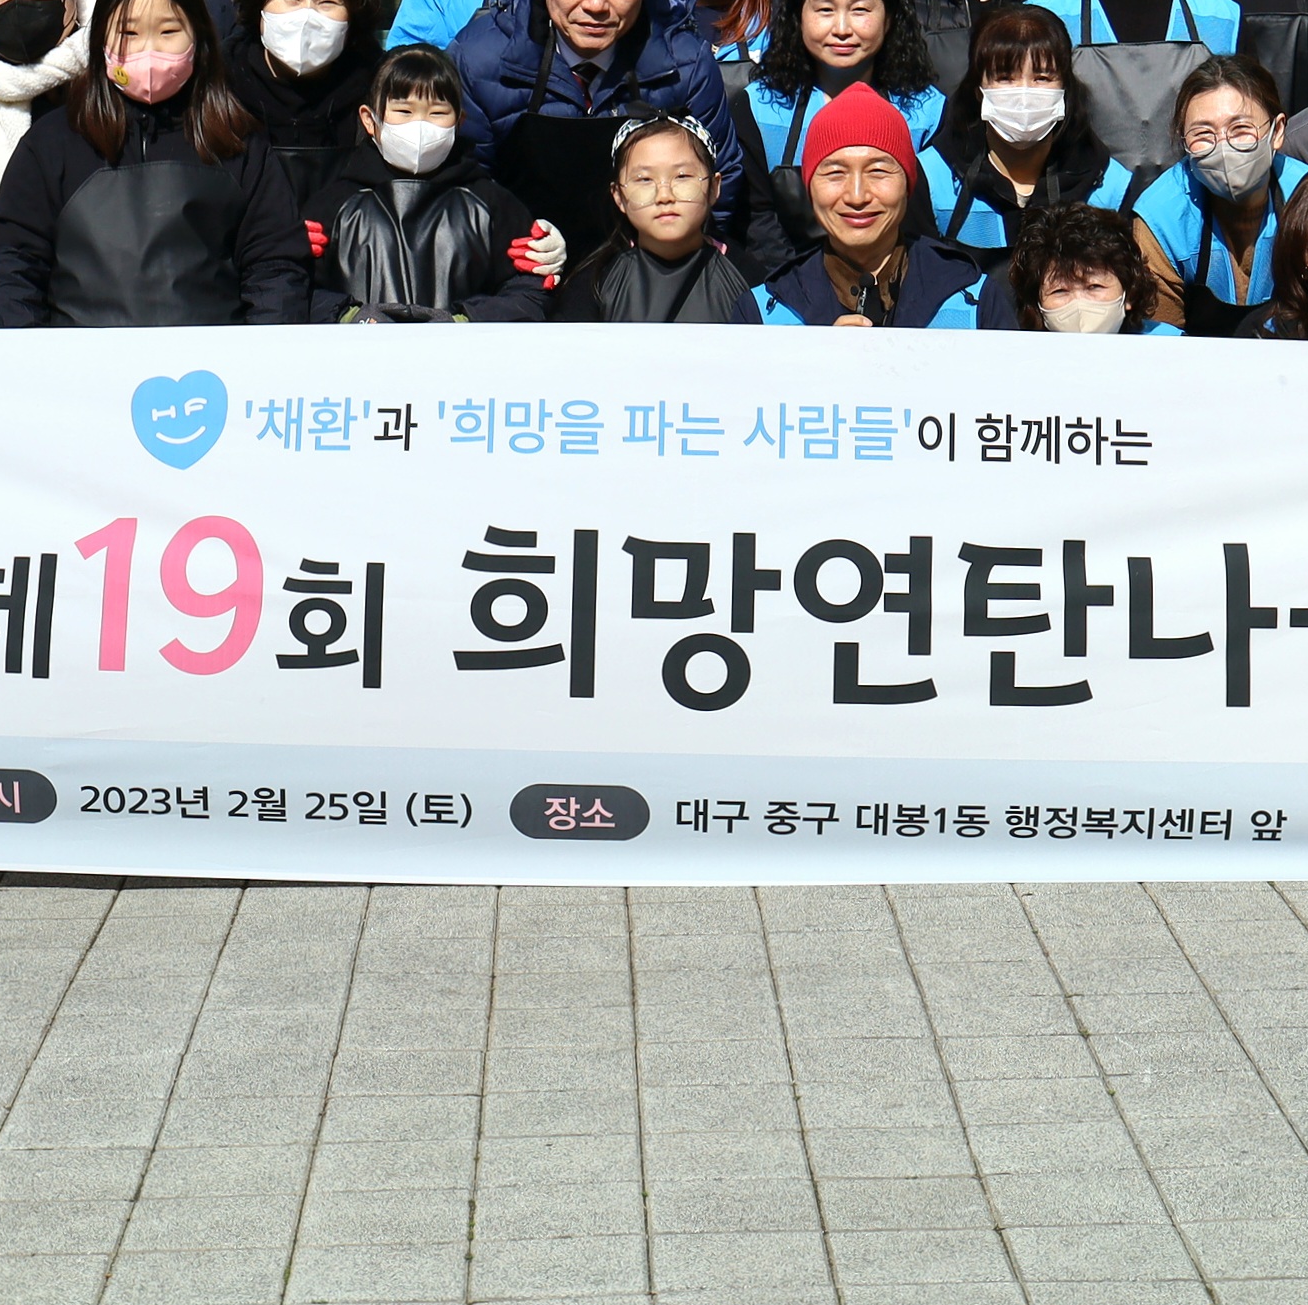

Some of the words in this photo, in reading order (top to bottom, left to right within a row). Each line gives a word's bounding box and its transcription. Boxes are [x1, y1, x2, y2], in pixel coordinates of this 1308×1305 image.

[245, 396, 419, 453] '채환'과
[437, 398, 606, 456] '희망을
[623, 402, 727, 458] 파는
[744, 404, 957, 463] 사람들'이
[976, 414, 1154, 467] 함께하는
[81, 786, 211, 821] 2023년
[229, 788, 288, 824] 2월
[305, 791, 389, 827] 25일
[406, 792, 473, 830] (토)
[544, 797, 617, 832] 장소
[677, 799, 751, 834] 대구
[764, 802, 841, 837] 중구
[857, 803, 991, 839] 대봉1동
[1006, 805, 1234, 842] 행정복지센터
[1251, 809, 1290, 843] 앞
